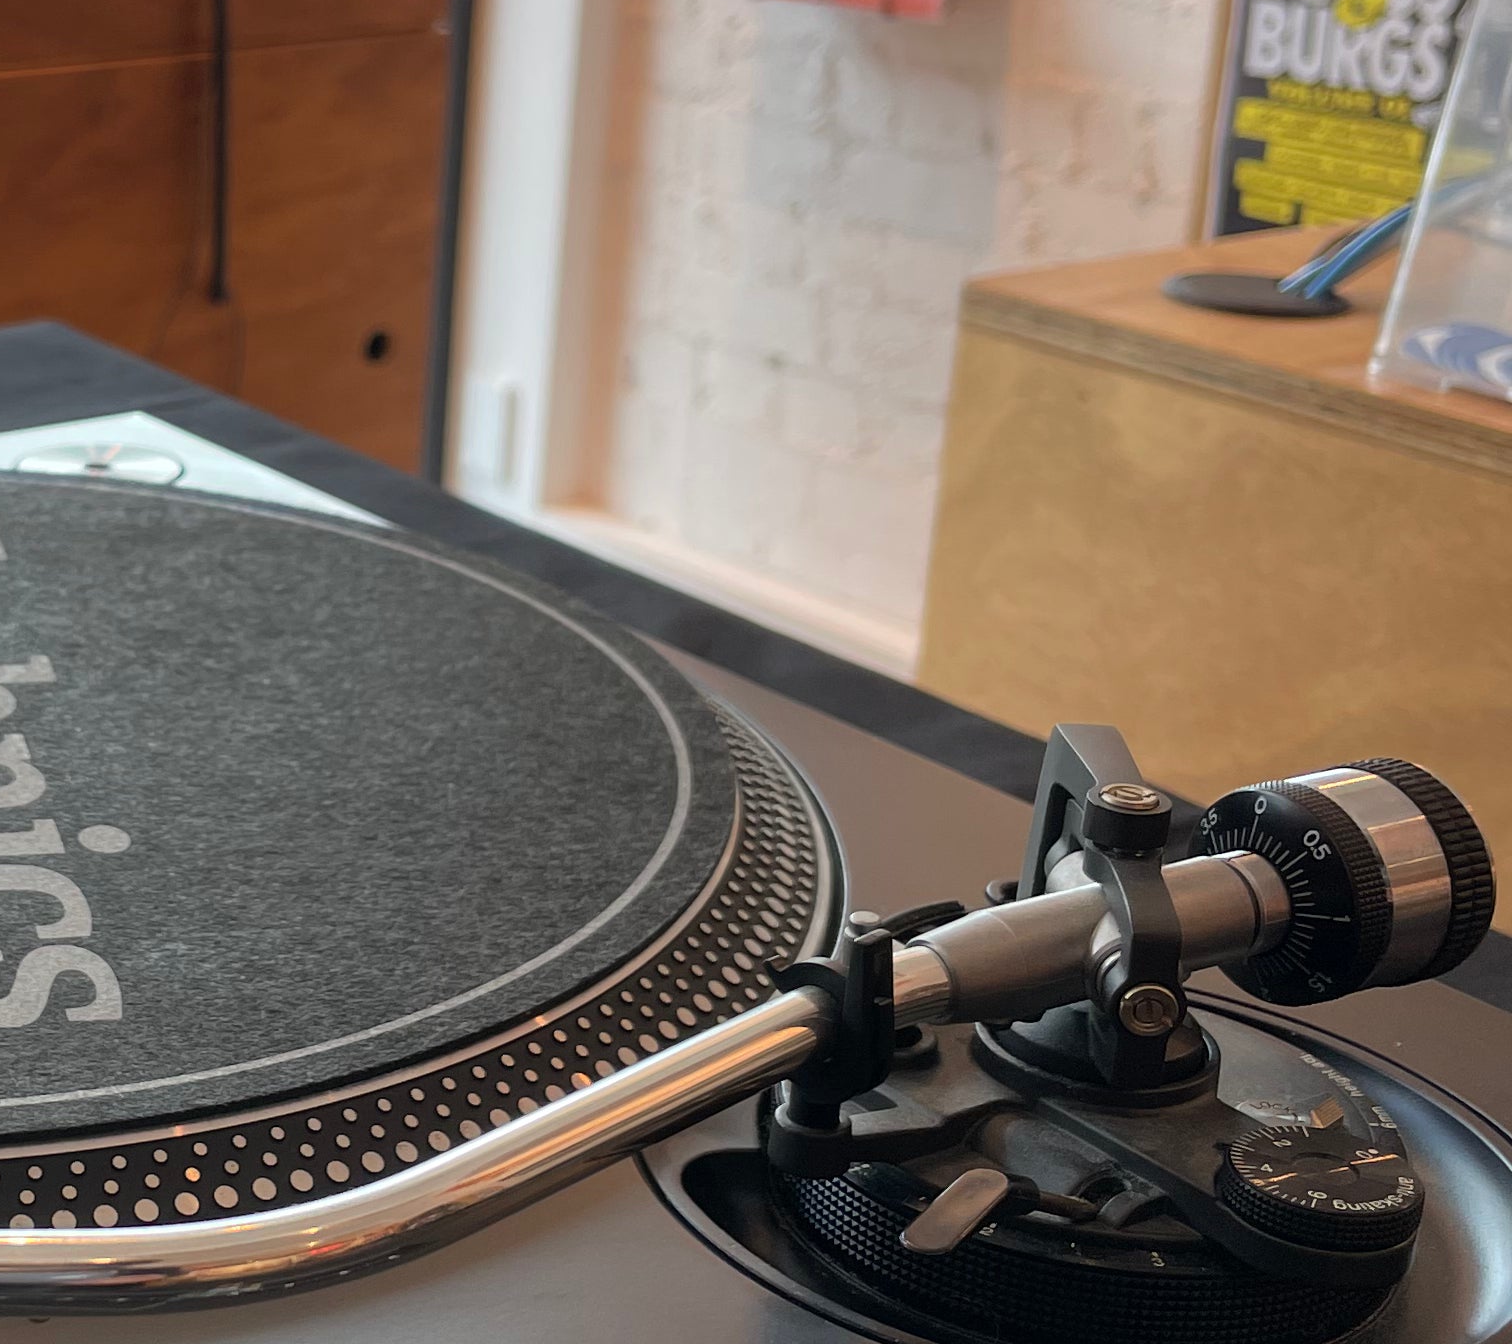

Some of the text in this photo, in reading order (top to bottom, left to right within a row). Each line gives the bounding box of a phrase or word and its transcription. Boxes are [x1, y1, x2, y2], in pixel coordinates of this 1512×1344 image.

[1244, 3, 1450, 101] BURGS
[1254, 796, 1267, 814] 0
[1200, 808, 1218, 835] 3.5
[1303, 829, 1332, 861] 0.5
[1272, 1138, 1292, 1148] 2
[1260, 1163, 1273, 1173] 4
[1307, 1190, 1327, 1200] 6
[1333, 1176, 1415, 1211] anti-skating
